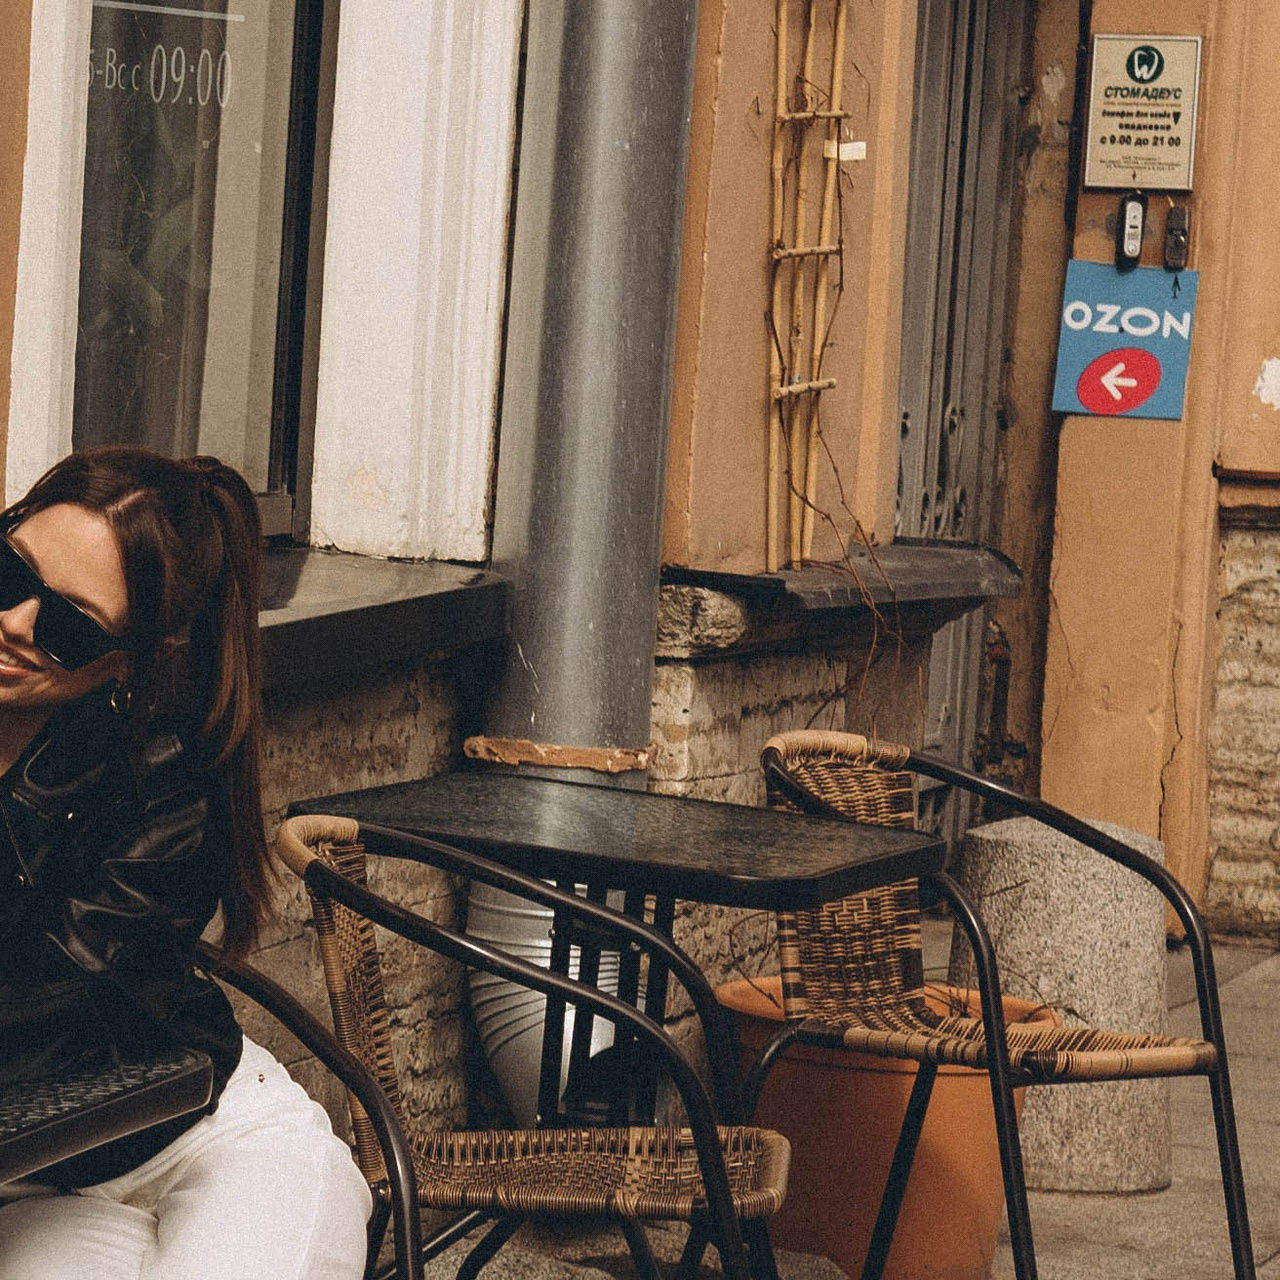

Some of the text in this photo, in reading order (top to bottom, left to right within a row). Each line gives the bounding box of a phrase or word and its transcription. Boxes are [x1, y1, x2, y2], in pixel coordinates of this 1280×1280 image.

[150, 45, 232, 108] 09:00
[1104, 86, 1183, 101] СТОМАДЕУС
[1134, 136, 1149, 148] до
[1063, 301, 1192, 341] OZON
